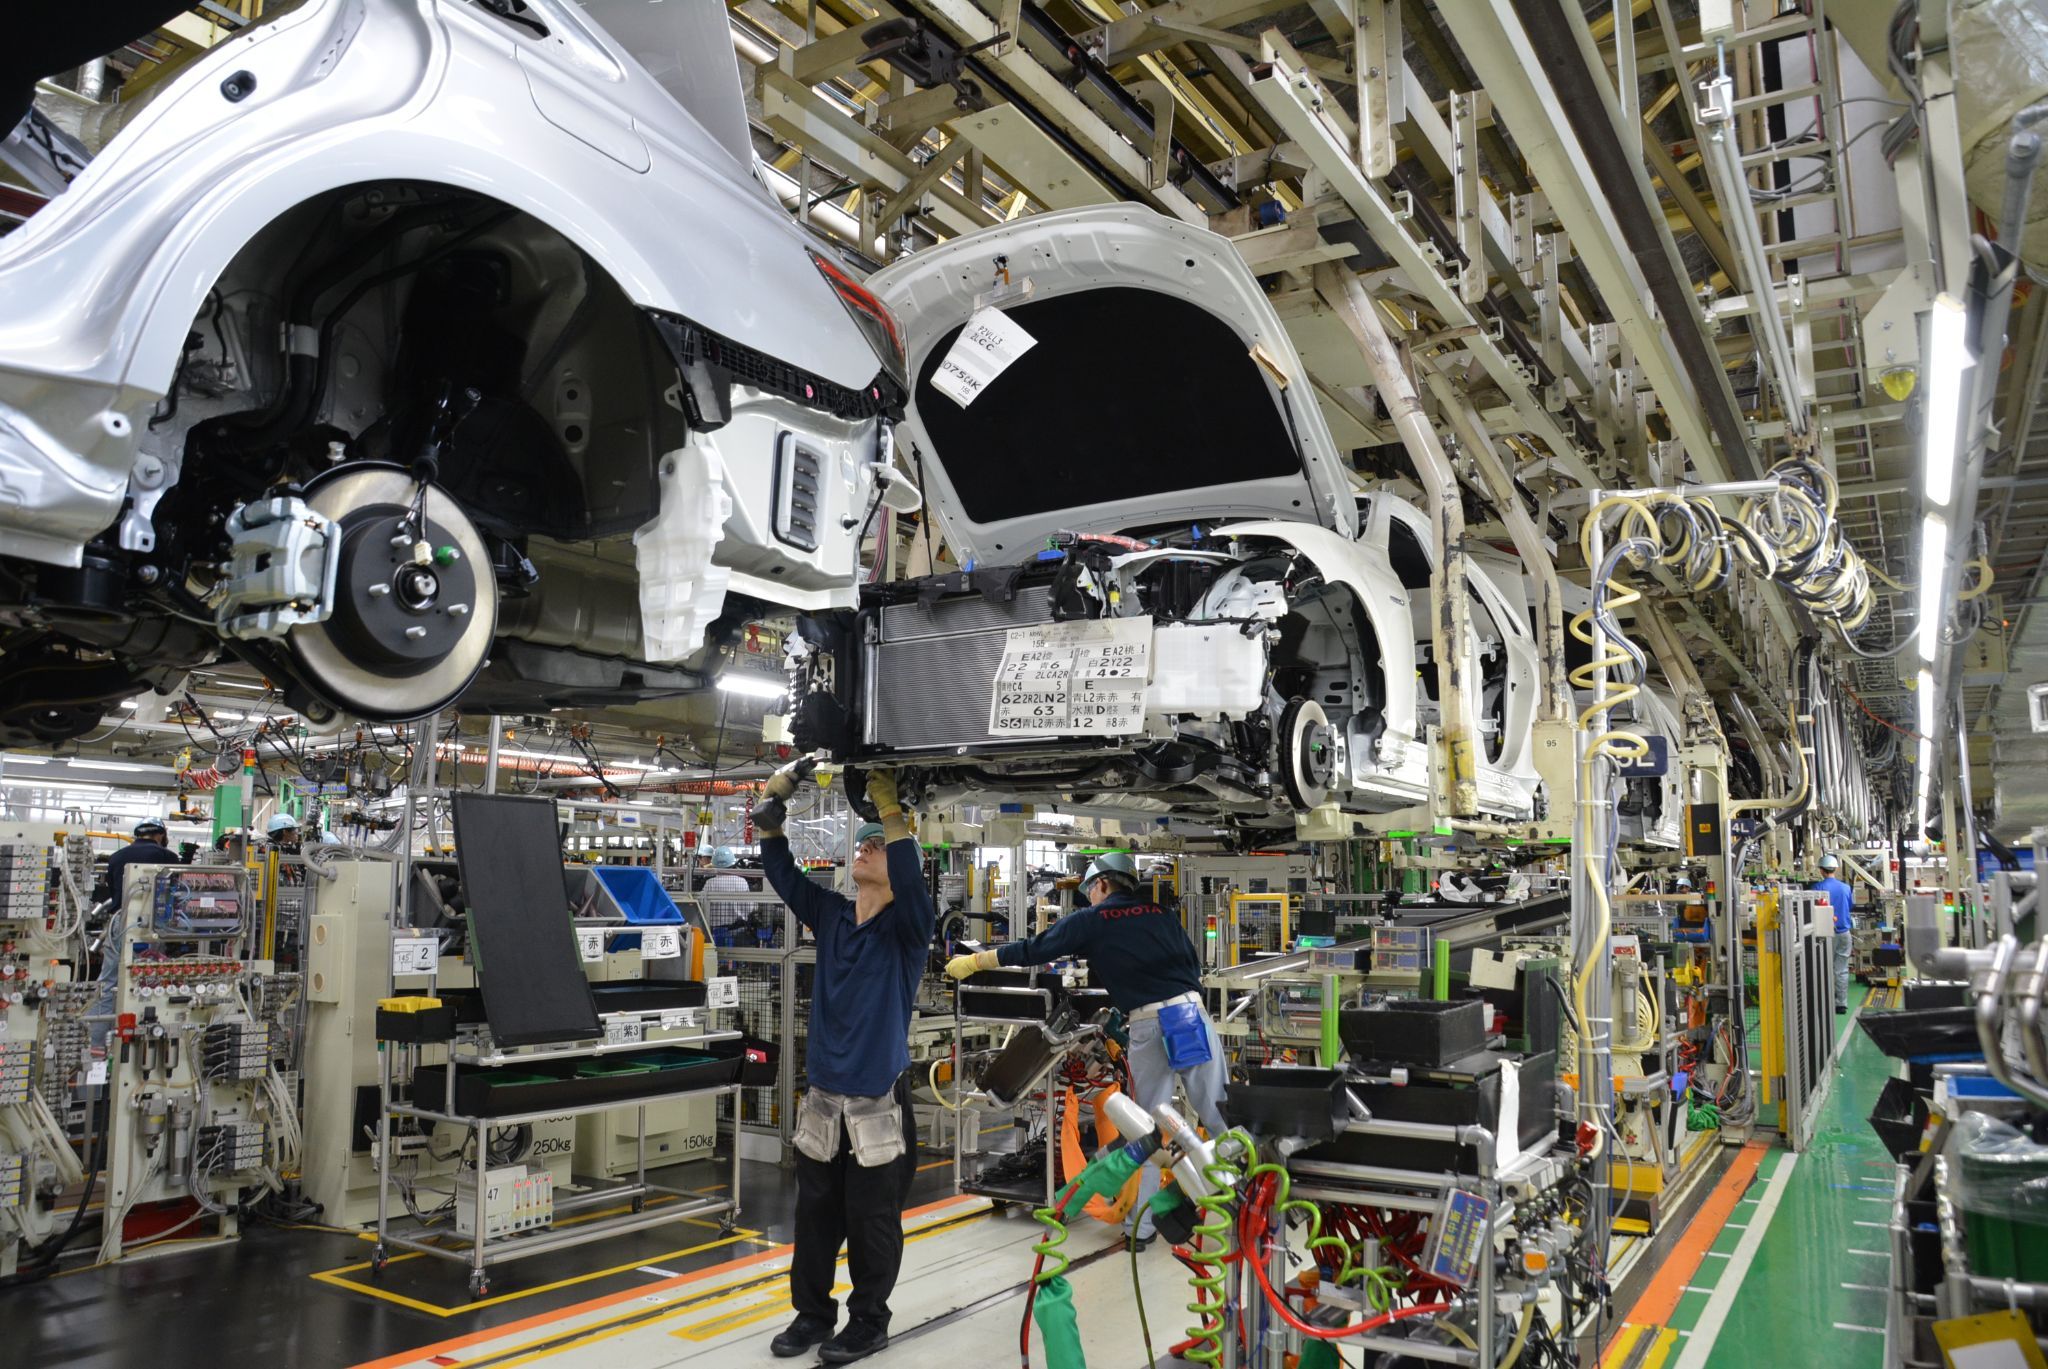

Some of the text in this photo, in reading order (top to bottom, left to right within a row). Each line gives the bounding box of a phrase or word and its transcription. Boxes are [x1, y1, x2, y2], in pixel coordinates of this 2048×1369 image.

[1056, 681, 1062, 690] 5
[1085, 680, 1094, 690] E
[1546, 739, 1557, 748] 95
[1731, 823, 1750, 833] 4L
[1099, 904, 1163, 920] TOYOTA
[588, 936, 599, 950] 赤
[659, 935, 673, 948] 赤
[421, 947, 429, 960] 2
[723, 983, 733, 997] 黒
[533, 1137, 572, 1155] 250kg
[683, 1134, 714, 1150] 150kg
[487, 1187, 499, 1201] 47
